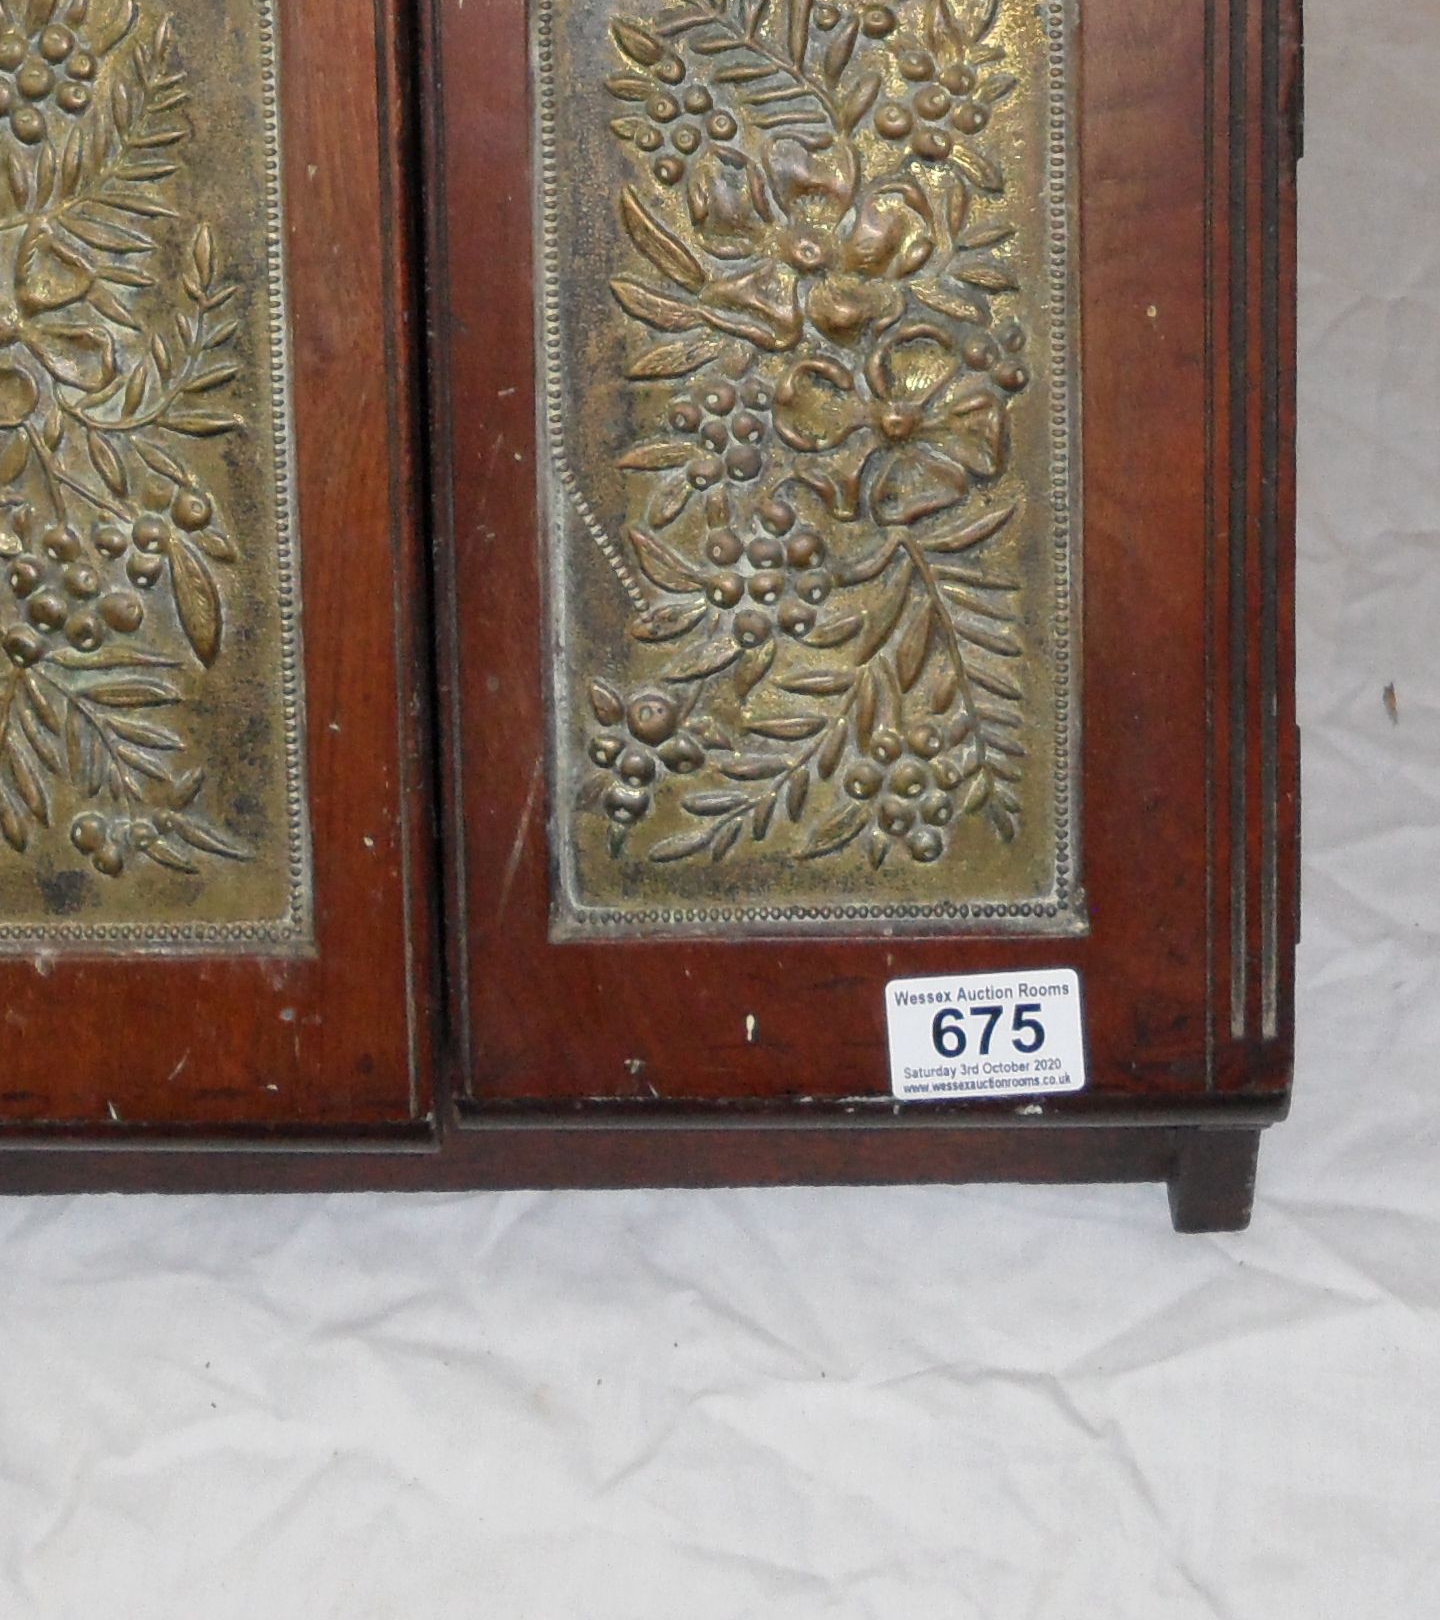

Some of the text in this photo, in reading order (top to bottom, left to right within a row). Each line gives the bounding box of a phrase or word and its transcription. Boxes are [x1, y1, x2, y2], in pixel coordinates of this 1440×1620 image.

[895, 982, 1069, 1006] Wessex Auction Rooms
[932, 1003, 1045, 1058] 675
[904, 1058, 1061, 1079] Saturday 3rd October 2020
[904, 1072, 1071, 1093] www.wessexauctionrooms.co.uk
